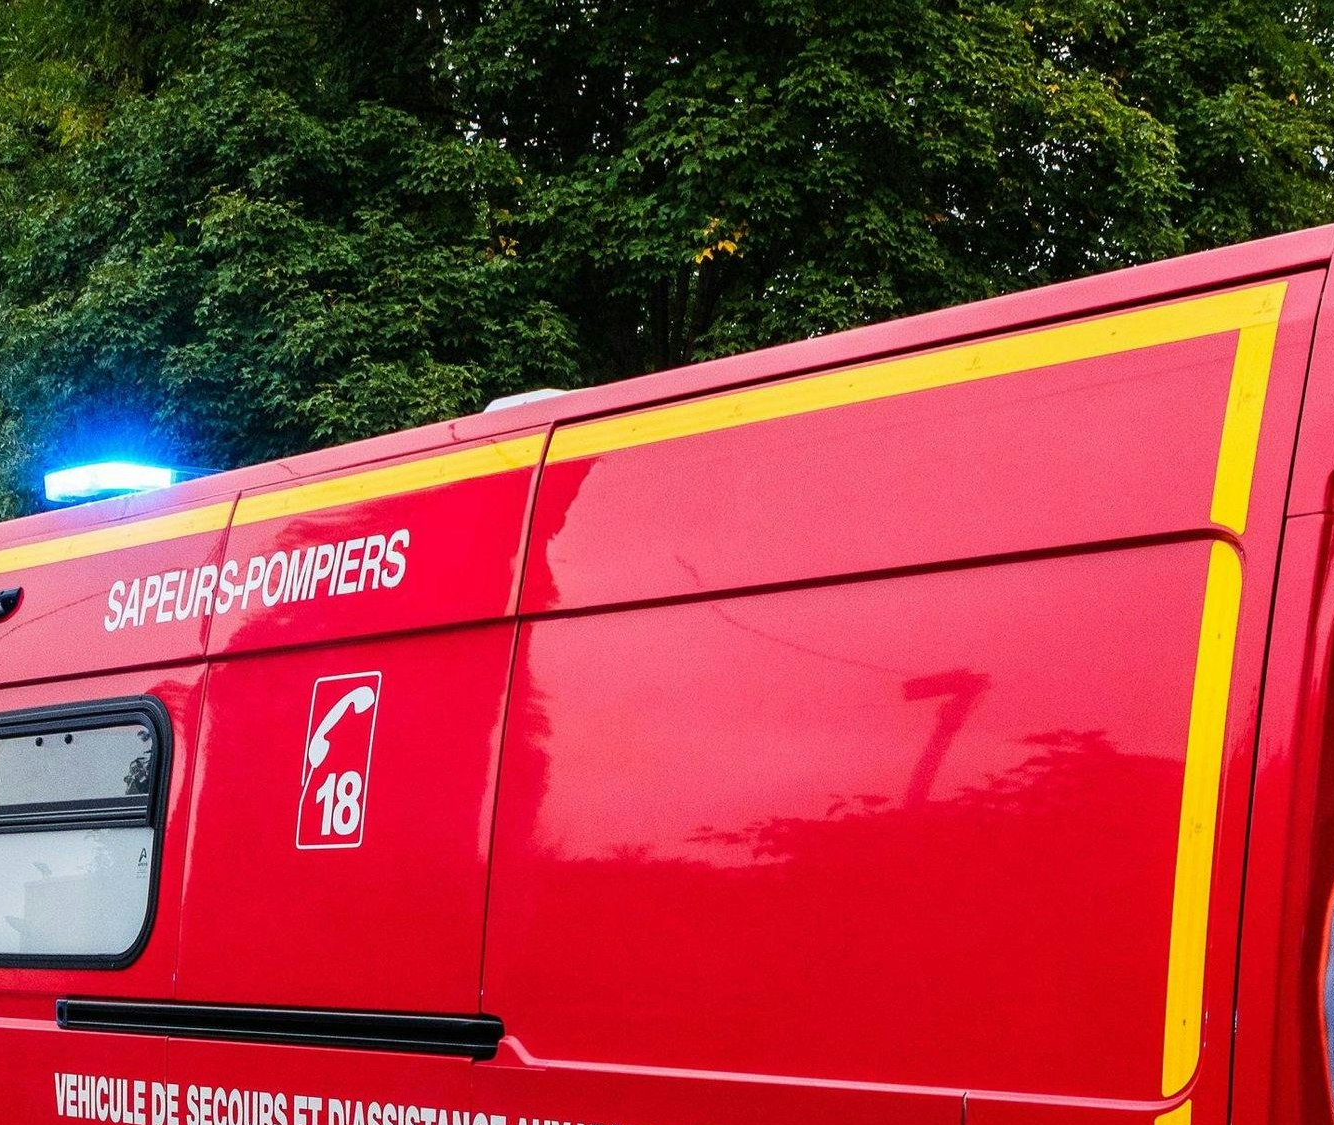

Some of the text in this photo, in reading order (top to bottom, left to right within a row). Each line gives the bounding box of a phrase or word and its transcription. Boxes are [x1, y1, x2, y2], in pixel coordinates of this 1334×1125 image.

[104, 529, 410, 632] SAPEURS-POMPIERS
[316, 771, 362, 835] 18
[54, 1072, 146, 1125] VEHICULE
